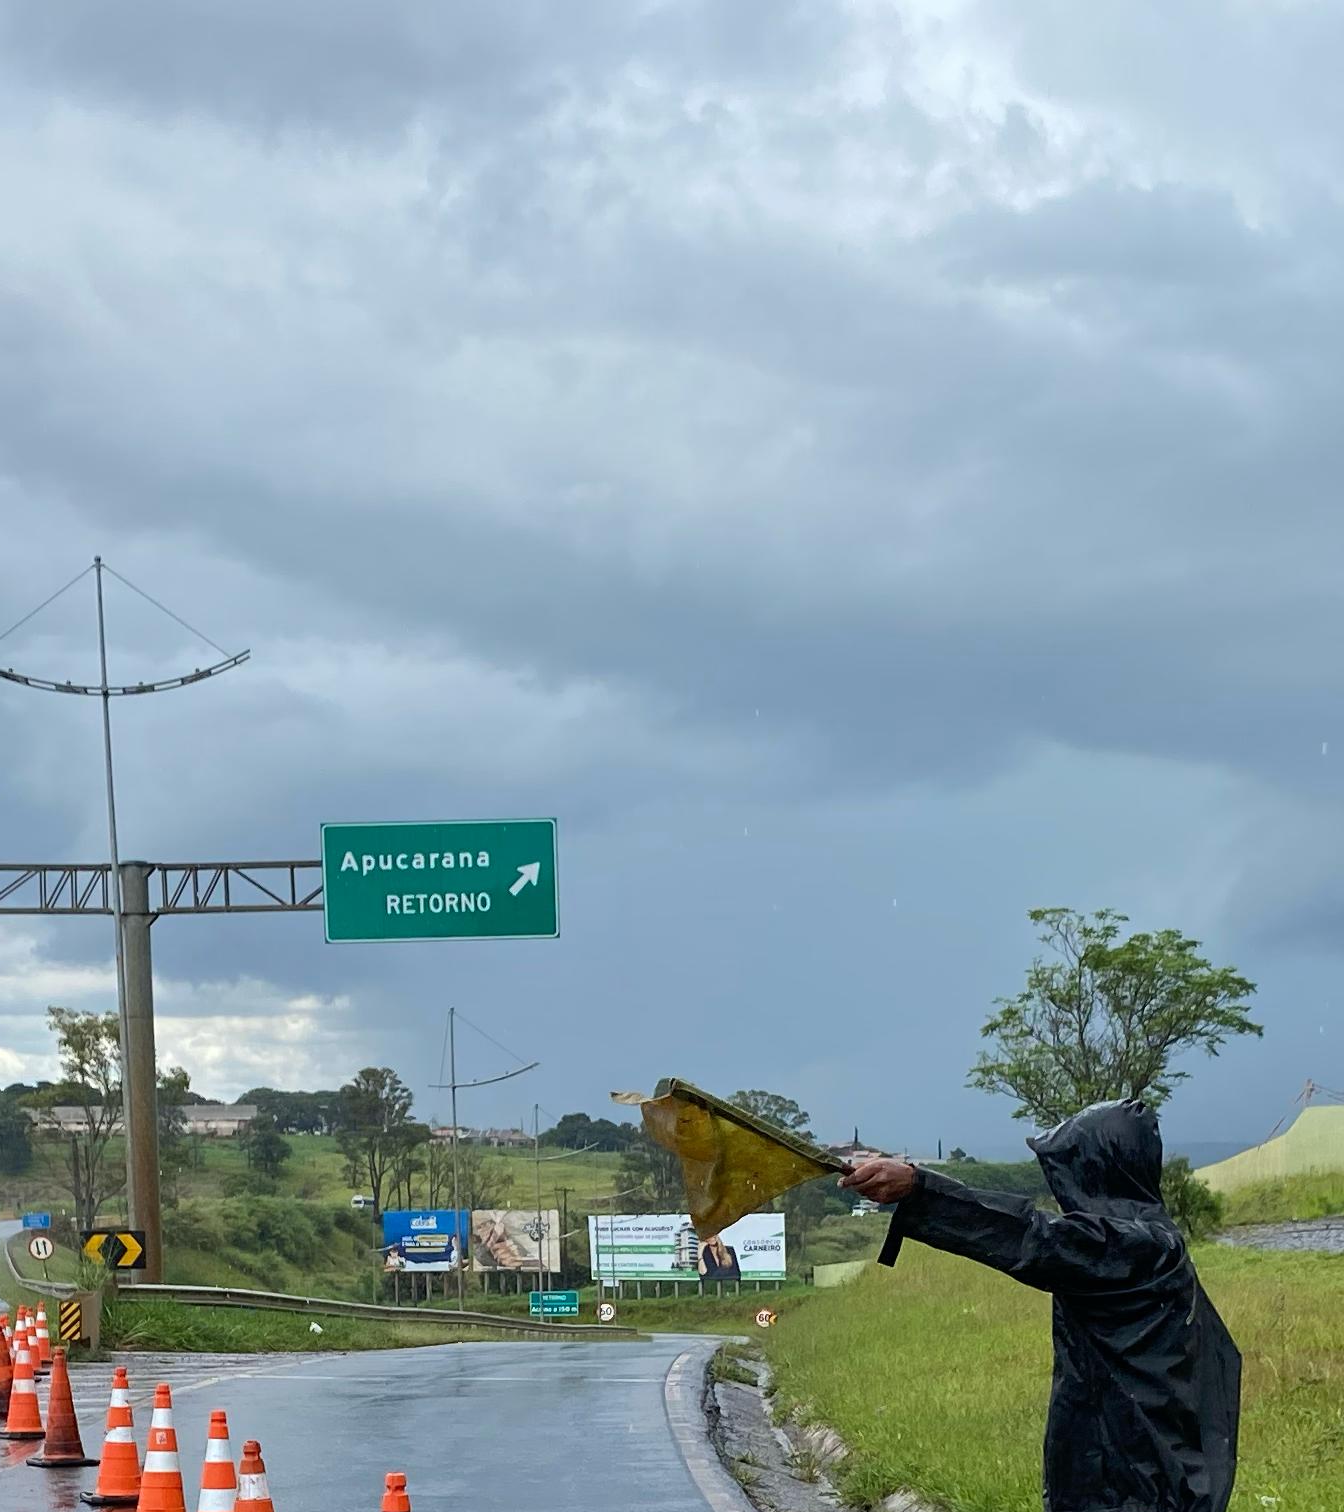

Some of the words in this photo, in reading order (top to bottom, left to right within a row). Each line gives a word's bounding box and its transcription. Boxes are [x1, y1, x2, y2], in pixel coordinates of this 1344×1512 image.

[340, 851, 491, 877] Apucarana
[385, 891, 492, 915] RETORNO
[758, 1313, 770, 1322] 60
